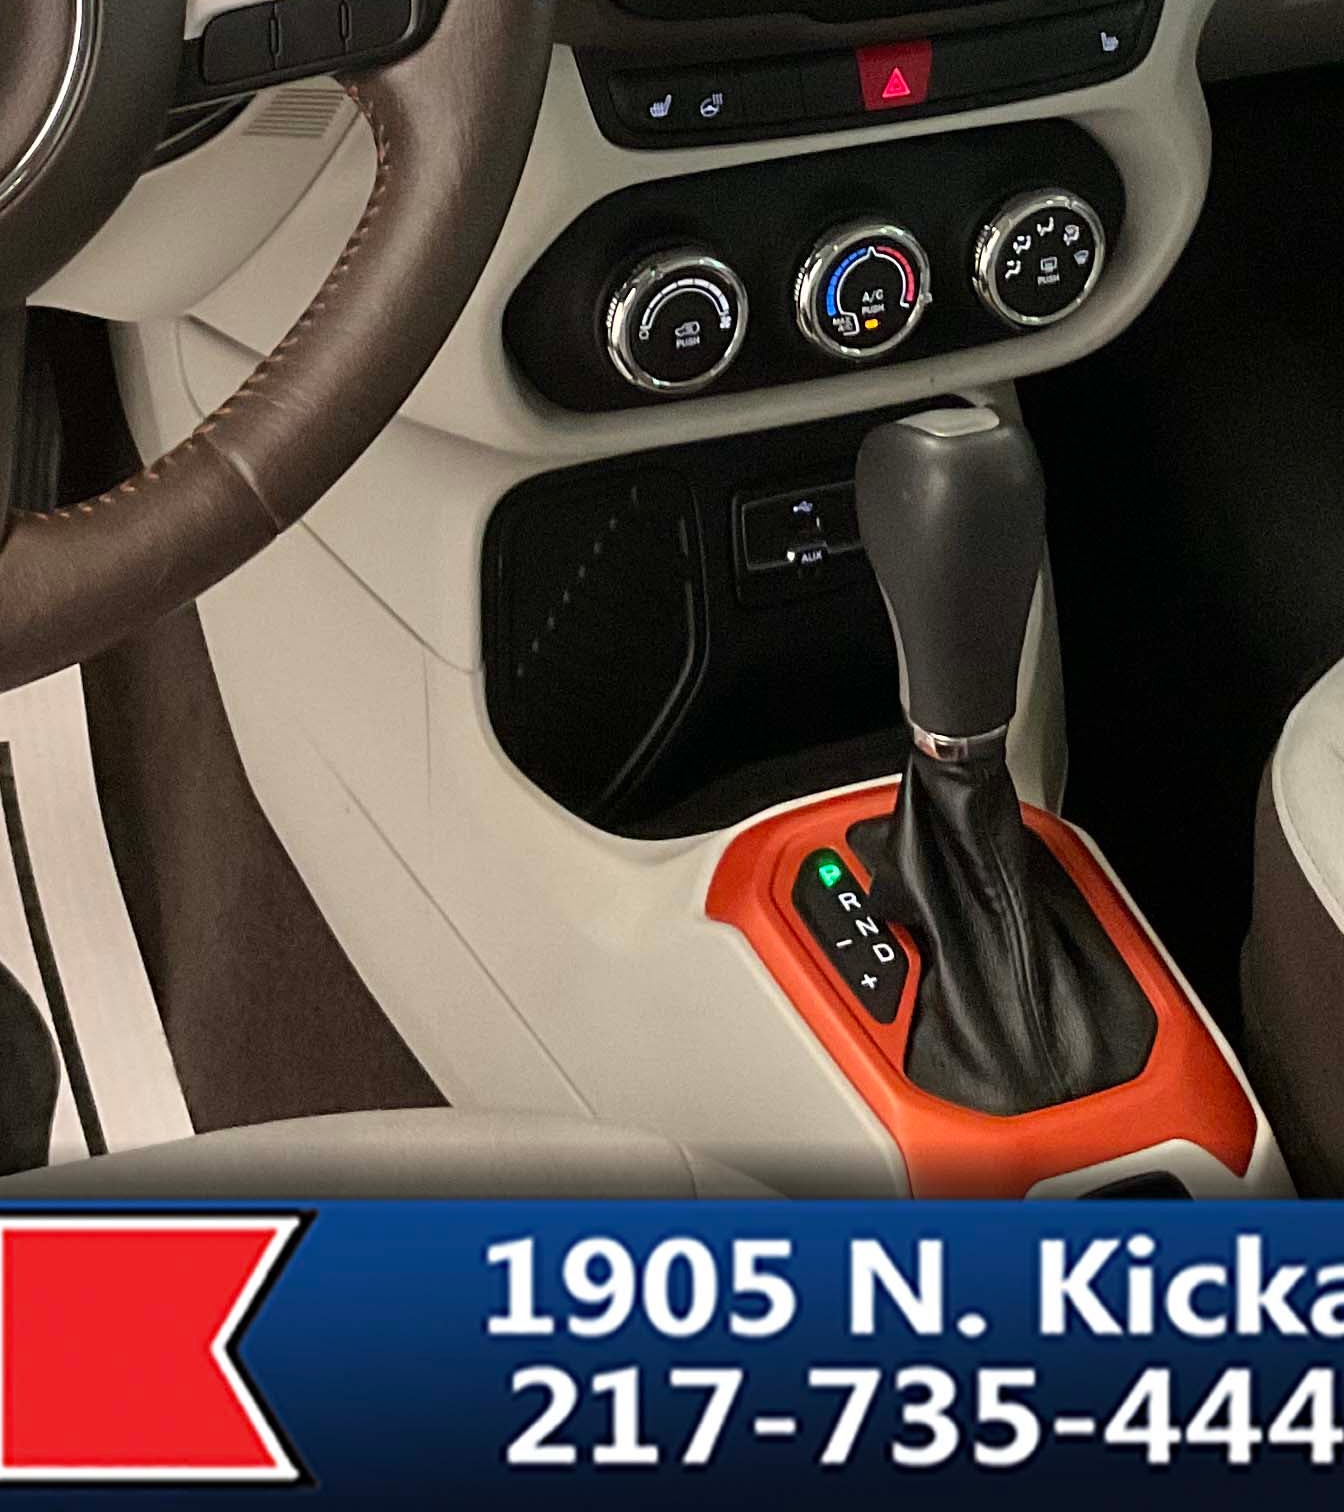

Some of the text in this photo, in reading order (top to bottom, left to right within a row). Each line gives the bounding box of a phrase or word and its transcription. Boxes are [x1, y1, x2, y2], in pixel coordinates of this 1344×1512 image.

[862, 288, 884, 303] A/C
[801, 550, 823, 564] AUX
[818, 864, 841, 887] P
[837, 891, 861, 911] R
[855, 916, 879, 937] N
[872, 942, 894, 963] D
